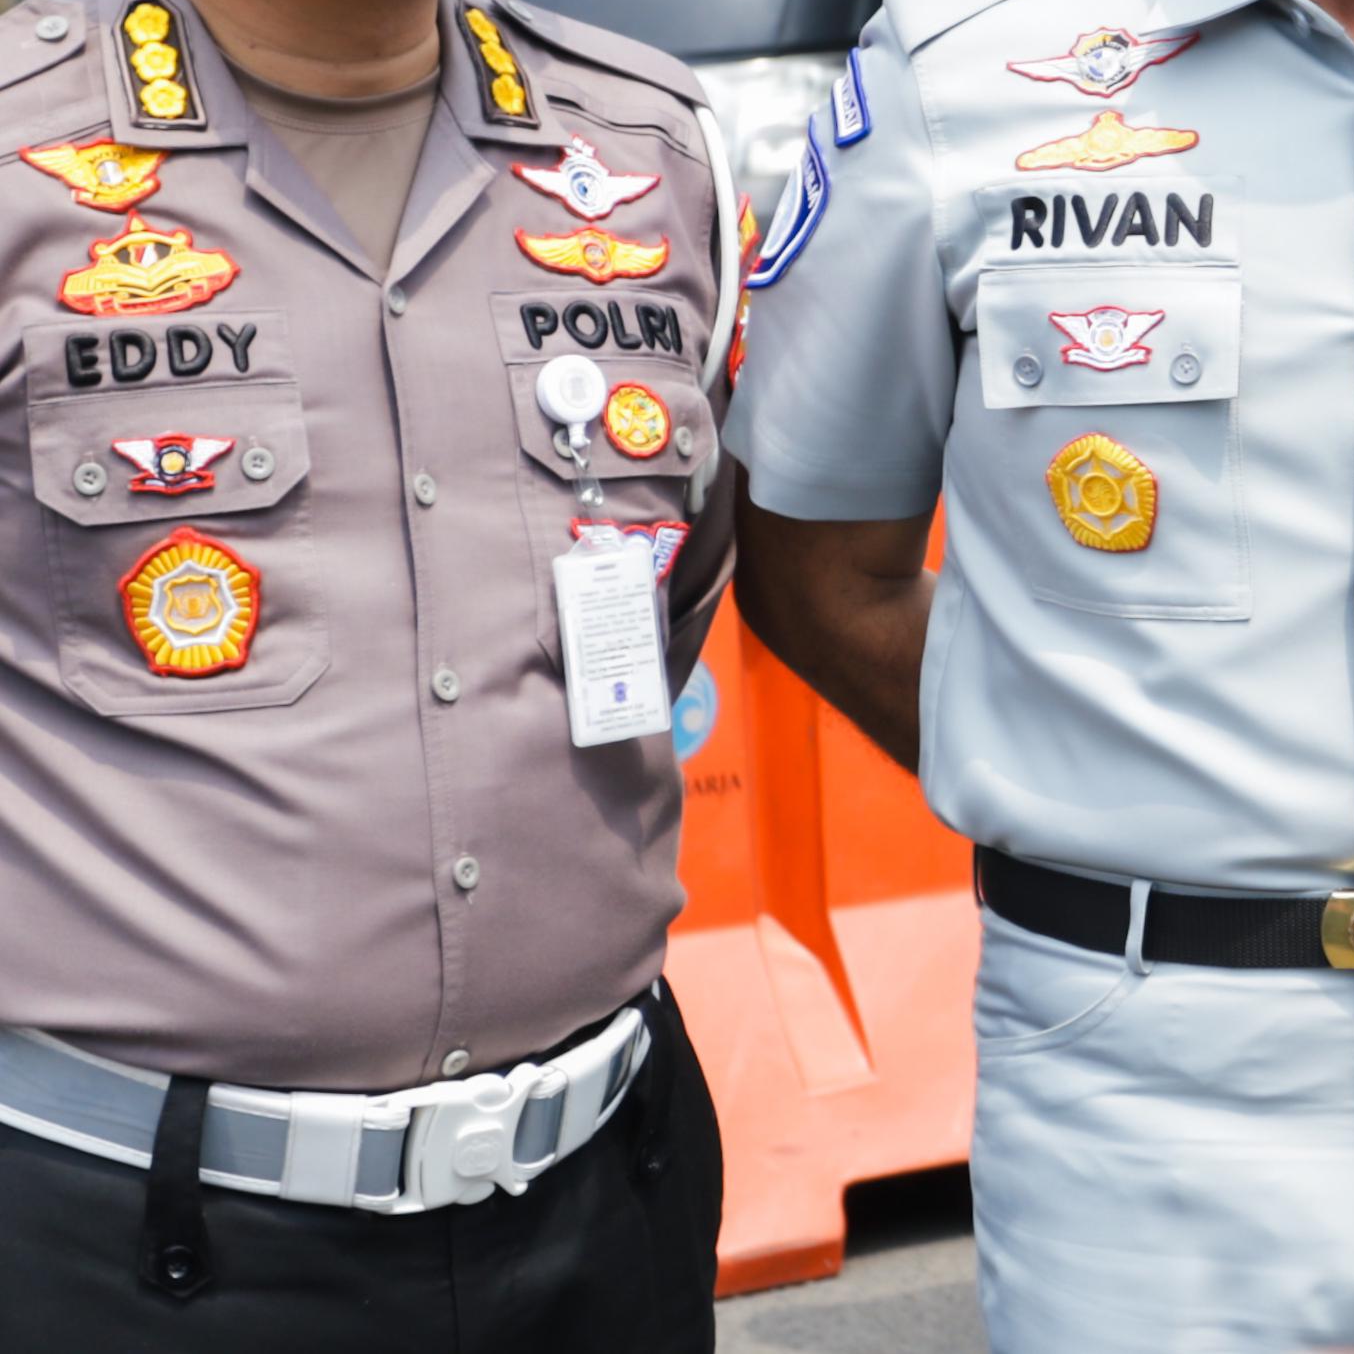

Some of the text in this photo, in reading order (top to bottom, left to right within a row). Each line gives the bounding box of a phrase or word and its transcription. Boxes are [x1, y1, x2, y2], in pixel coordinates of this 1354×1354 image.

[1010, 191, 1215, 251] RIVAN
[65, 323, 257, 388] EDDY
[519, 299, 684, 356] POLRI
